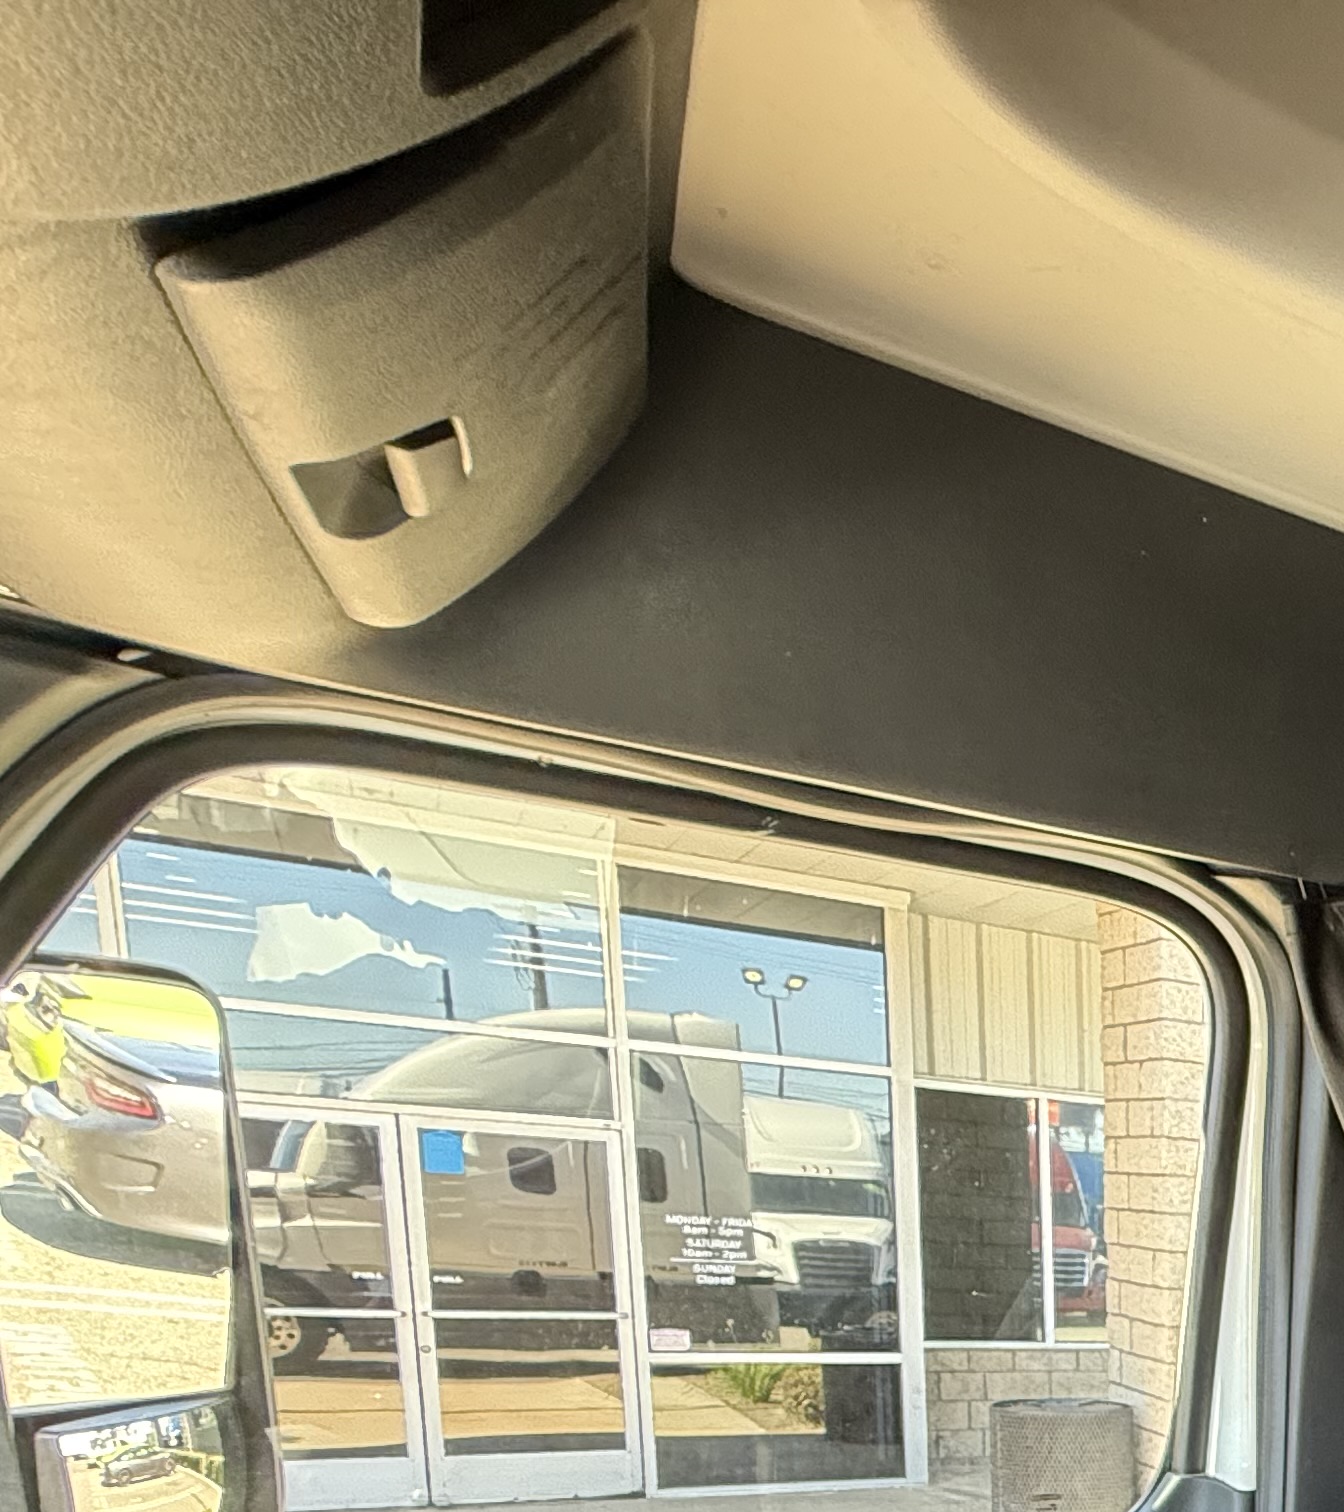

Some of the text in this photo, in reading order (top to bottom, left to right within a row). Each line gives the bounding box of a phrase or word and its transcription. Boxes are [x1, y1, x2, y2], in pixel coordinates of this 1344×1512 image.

[665, 1214, 712, 1226] MONDAY
[721, 1217, 755, 1227] FRIDA
[685, 1237, 742, 1249] SATURDAY
[721, 1250, 748, 1260] 2pm
[692, 1263, 736, 1274] SUNDAY
[695, 1274, 737, 1286] Closed
